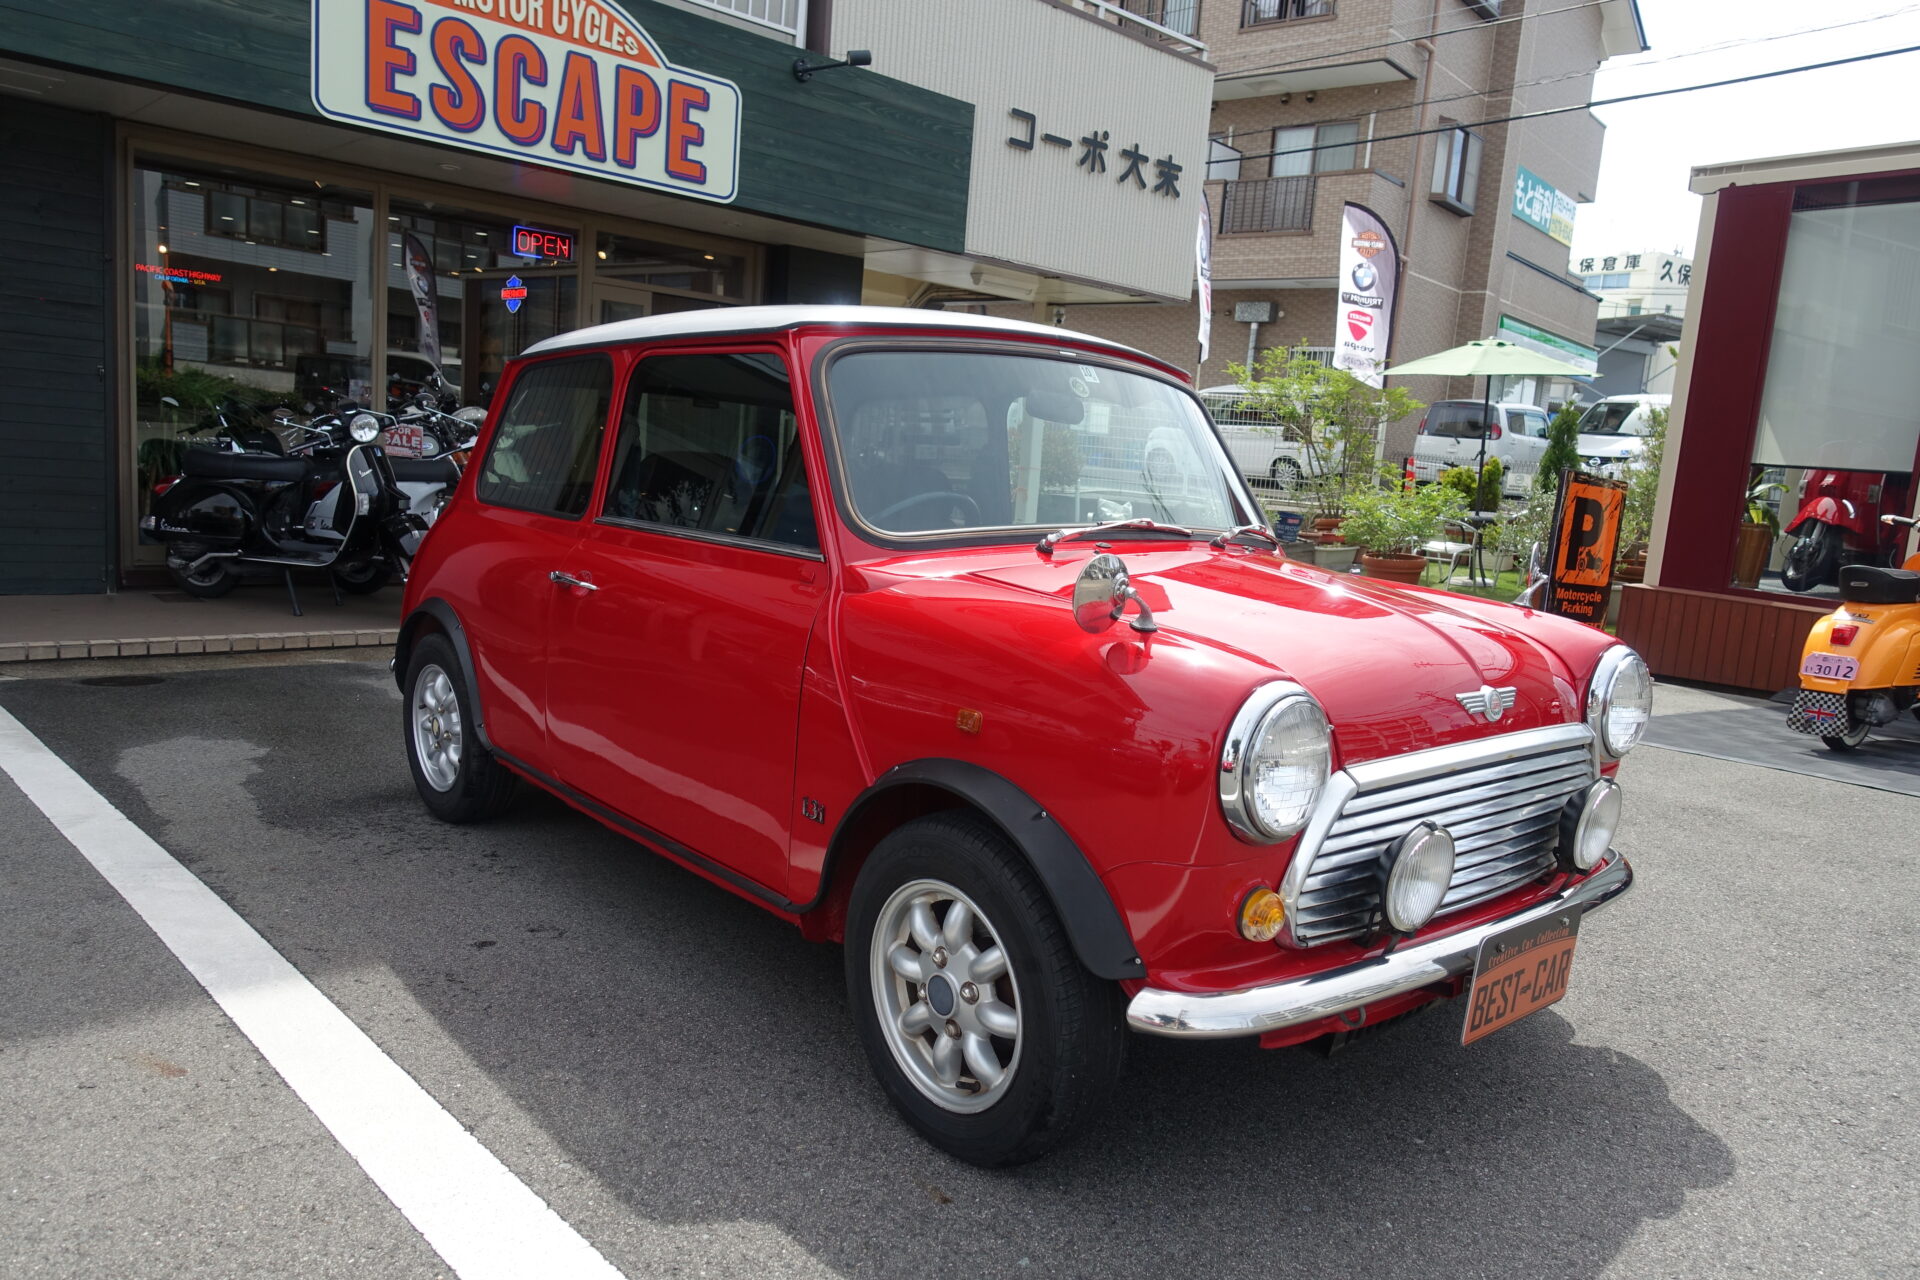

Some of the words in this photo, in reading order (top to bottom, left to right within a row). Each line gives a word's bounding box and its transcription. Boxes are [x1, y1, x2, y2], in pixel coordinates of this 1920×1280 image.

[454, 0, 545, 29] TOR
[552, 0, 639, 56] CYCLES
[365, 0, 710, 184] ESCAPE
[517, 231, 569, 258] OPEN
[135, 263, 163, 274] PACIFIC
[164, 267, 188, 278] COAST
[189, 270, 222, 282] HIGHWAY
[1566, 497, 1604, 570] P
[1556, 588, 1602, 602] Motorcycle
[1562, 601, 1594, 616] Parking
[1814, 664, 1854, 679] 3012
[1522, 939, 1534, 952] Car
[1470, 948, 1572, 1032] BEST-CAR
